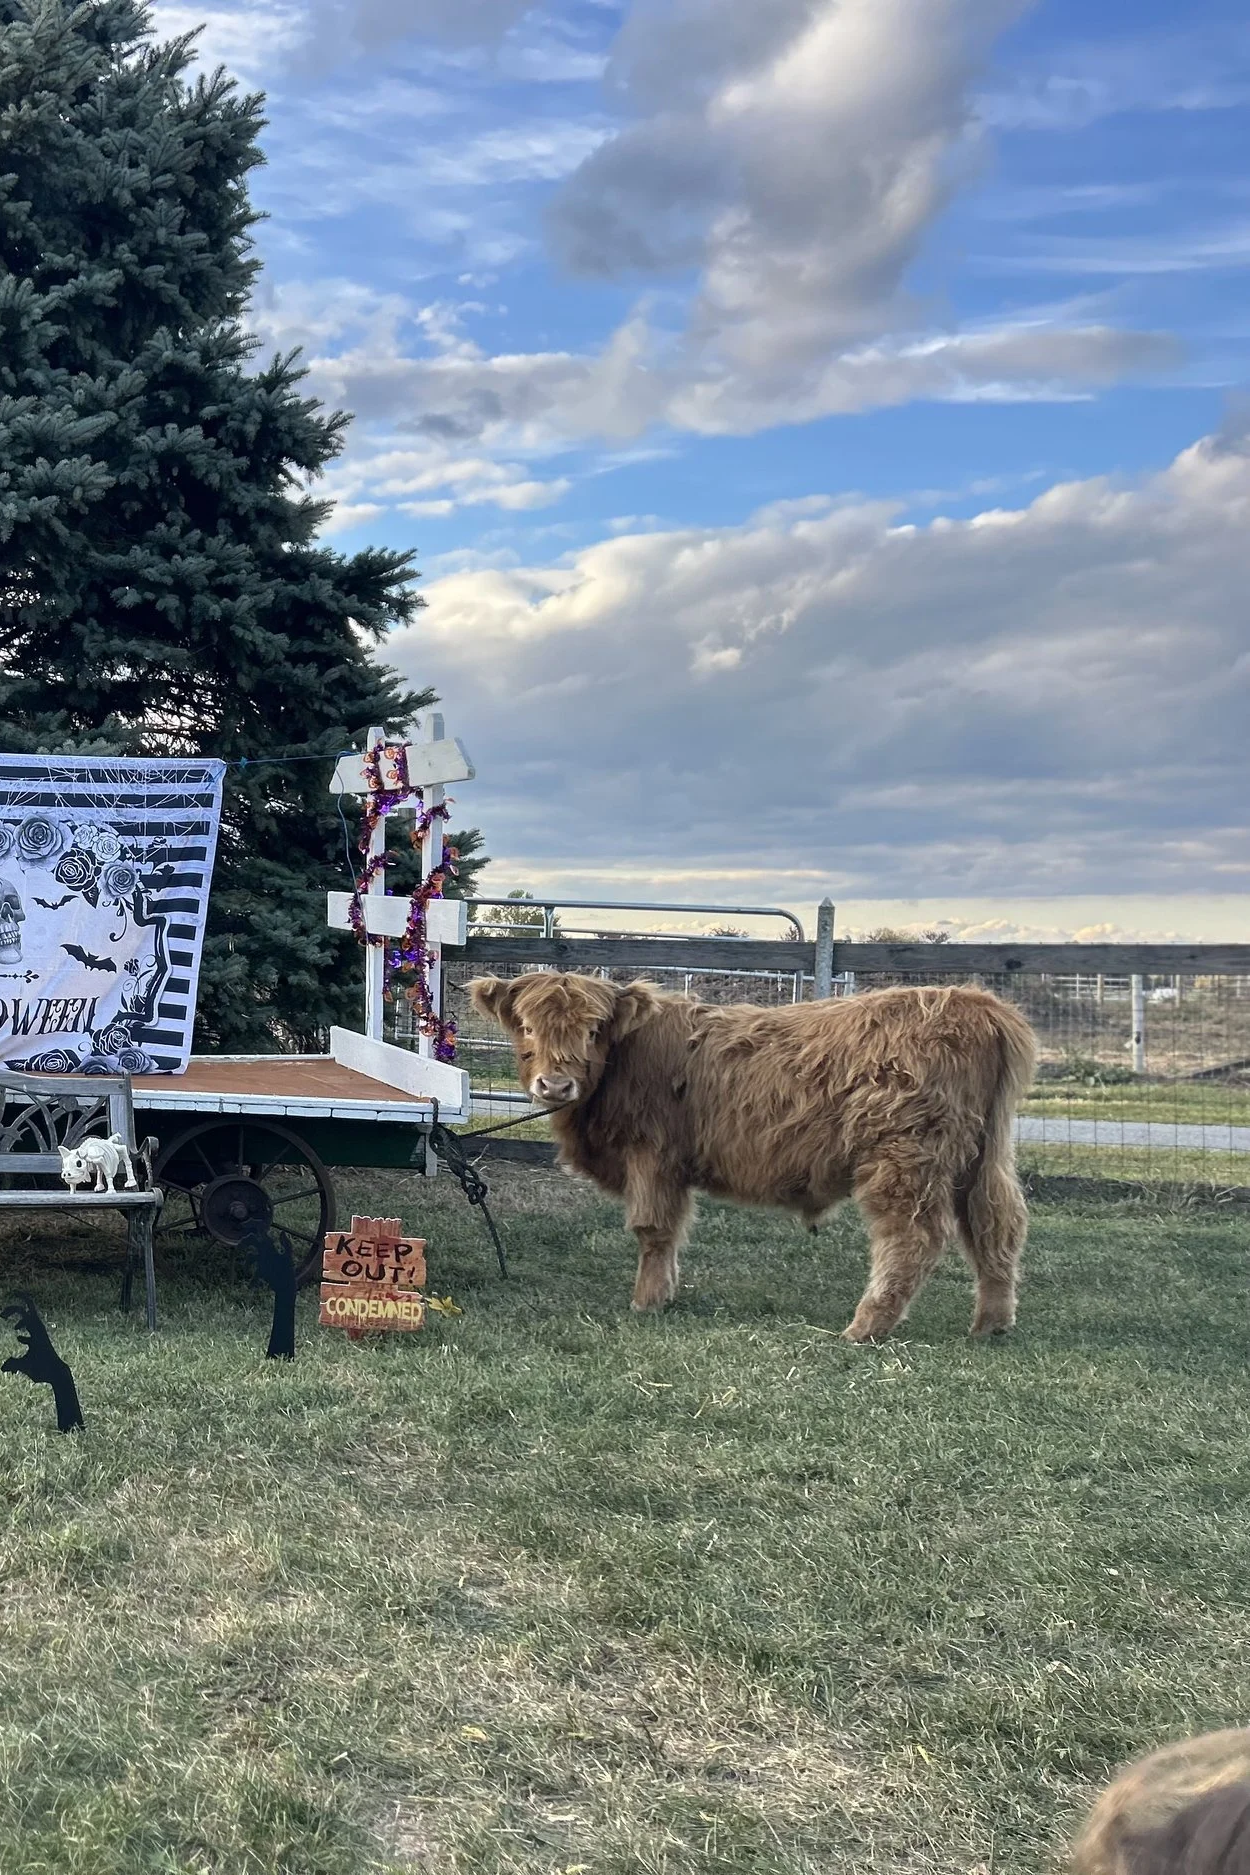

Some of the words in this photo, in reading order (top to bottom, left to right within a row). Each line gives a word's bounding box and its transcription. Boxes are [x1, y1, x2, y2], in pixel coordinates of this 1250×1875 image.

[336, 1235, 413, 1262] KEEP
[341, 1260, 415, 1284] OUT!
[326, 1297, 423, 1322] CONDEMNED
